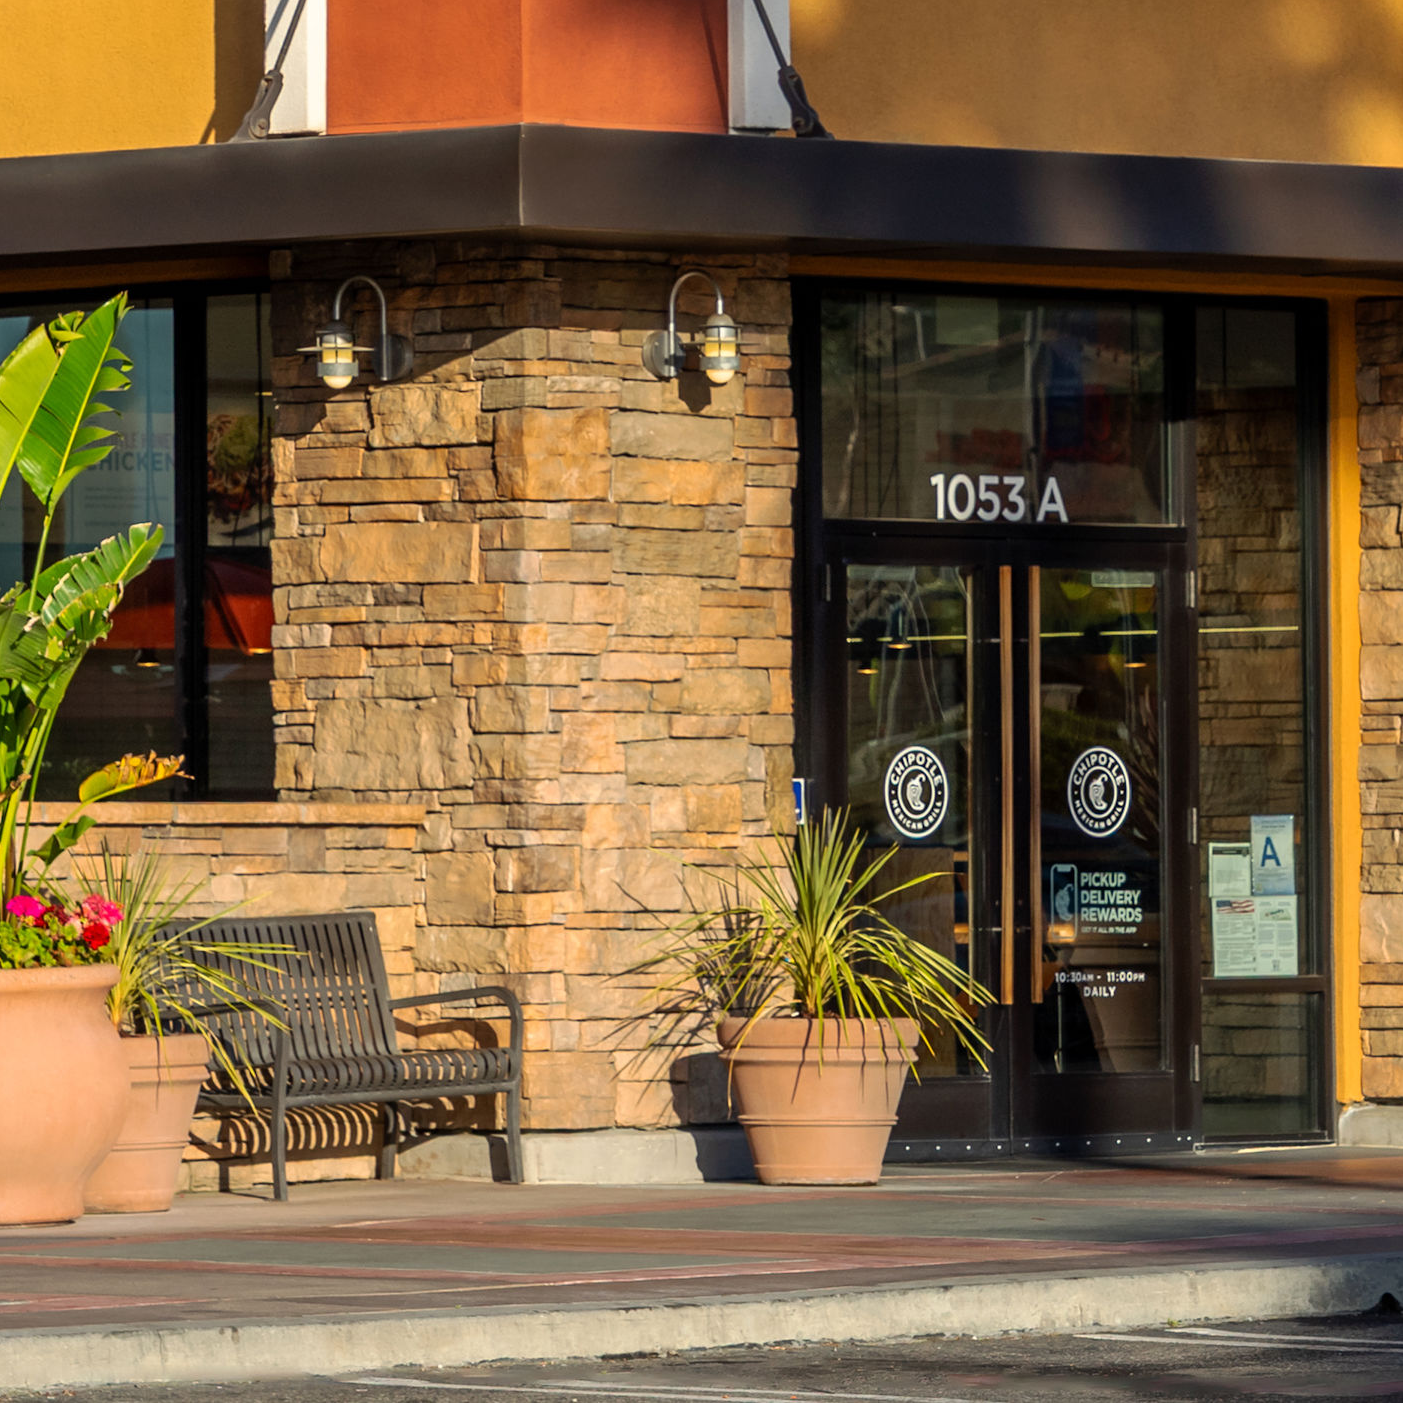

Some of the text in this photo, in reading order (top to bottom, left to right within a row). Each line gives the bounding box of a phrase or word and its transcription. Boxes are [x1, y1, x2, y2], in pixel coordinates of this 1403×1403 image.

[86, 451, 175, 471] HICKEN
[930, 473, 1069, 523] 1053 A
[890, 752, 943, 786] CHIPOTLE
[1073, 753, 1125, 786] CHIPOTLE
[1261, 836, 1281, 867] A
[1080, 872, 1127, 887] PICKUP
[1080, 890, 1141, 905] DELIVERY
[1081, 907, 1143, 923] REWARDS
[1106, 971, 1146, 983] 11:00PM
[1083, 986, 1117, 997] DAILY
